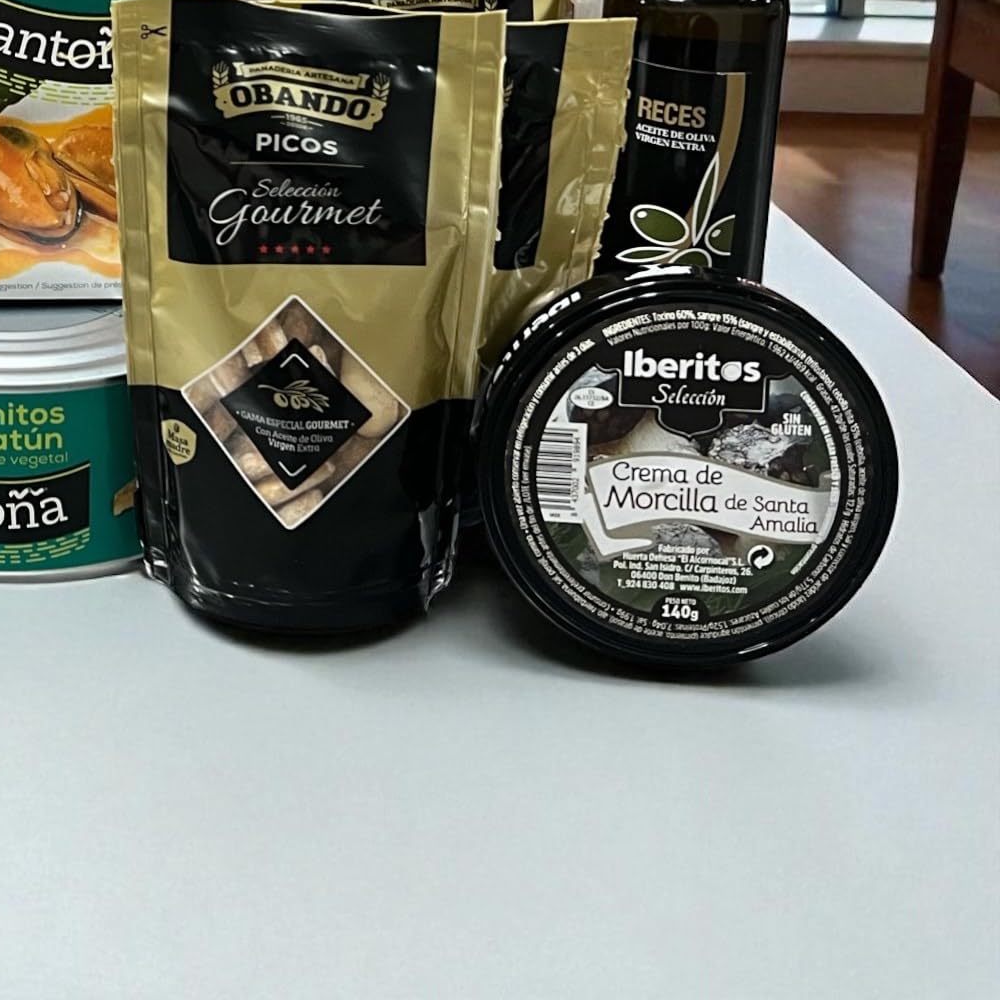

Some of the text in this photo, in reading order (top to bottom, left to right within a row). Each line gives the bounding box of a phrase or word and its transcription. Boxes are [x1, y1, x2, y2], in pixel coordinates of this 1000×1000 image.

[303, 71, 355, 86] ARTESANA
[229, 83, 371, 121] OBANDO
[637, 95, 707, 129] RECES
[635, 122, 716, 143] ACEITE DE OLIVA
[635, 131, 706, 152] VIRGEN EXTRA
[255, 133, 339, 156] PICOS
[252, 178, 342, 198] Selección
[208, 187, 384, 246] Gourmet
[623, 348, 761, 382] Iberitos
[651, 384, 726, 406] Selección
[240, 410, 350, 431] GAMA ESPECIAL GOURMET
[783, 412, 800, 425] SIN
[255, 426, 334, 443] Con Aceite de Oliva
[770, 423, 812, 436] GLUTEN
[268, 437, 320, 453] Virgen Extra
[9, 451, 69, 468] vegetal
[612, 461, 723, 485] Crema de
[603, 485, 809, 514] Morcilla de Santa
[749, 516, 818, 534] Amalia
[622, 552, 648, 561] Huerta
[657, 543, 710, 556] Fabricado por
[613, 560, 627, 569] Pol.
[629, 561, 643, 570] Ind.
[645, 562, 658, 571] San
[684, 564, 693, 573] C/
[631, 571, 737, 586] 06400 Don Benito (Badajoz)
[642, 580, 658, 589] 830
[659, 580, 675, 590] 408
[680, 583, 748, 594] www.iberitos.com
[665, 597, 697, 606] PESO NETO
[661, 604, 699, 622] 140g
